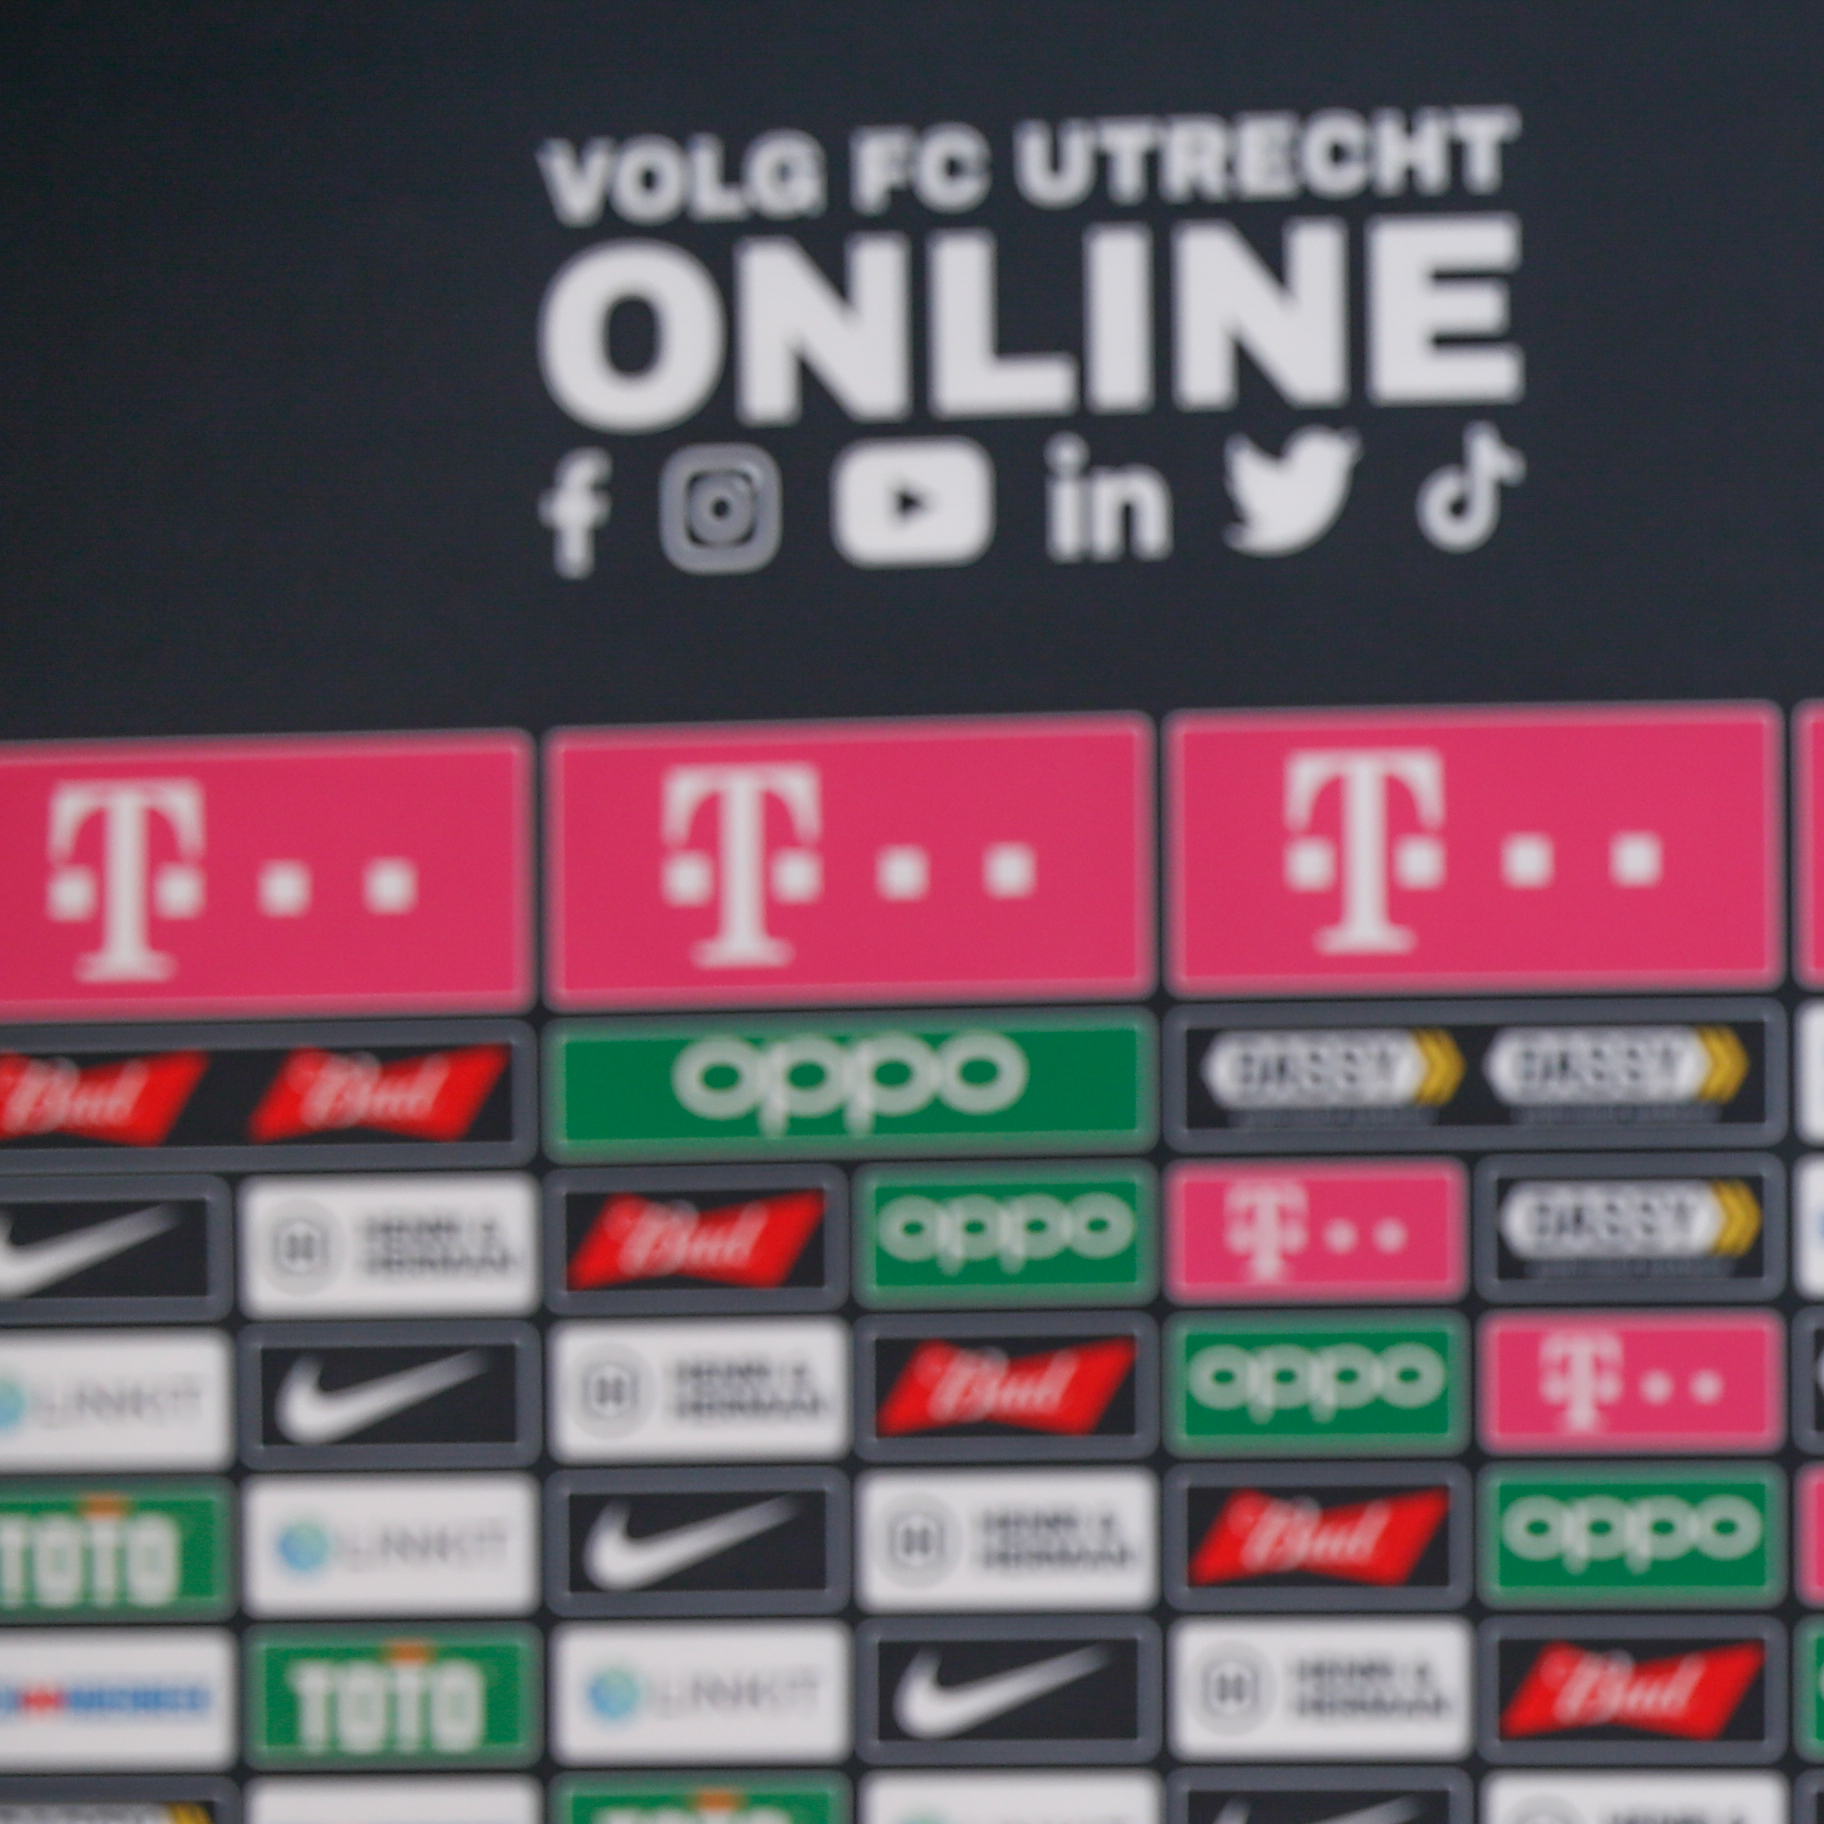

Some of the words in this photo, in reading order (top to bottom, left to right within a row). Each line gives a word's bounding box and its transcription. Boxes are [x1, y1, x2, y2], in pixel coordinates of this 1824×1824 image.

[539, 132, 824, 224] VOLG
[851, 124, 993, 213] FC
[1013, 103, 1522, 208] UTRECHT
[537, 212, 1524, 434] ONLINE
[671, 1028, 1030, 1139] oppo
[878, 1195, 1134, 1275] oppo
[1188, 1344, 1446, 1423] oppo
[1501, 1496, 1762, 1575] oppo
[286, 1659, 485, 1751] TOTO
